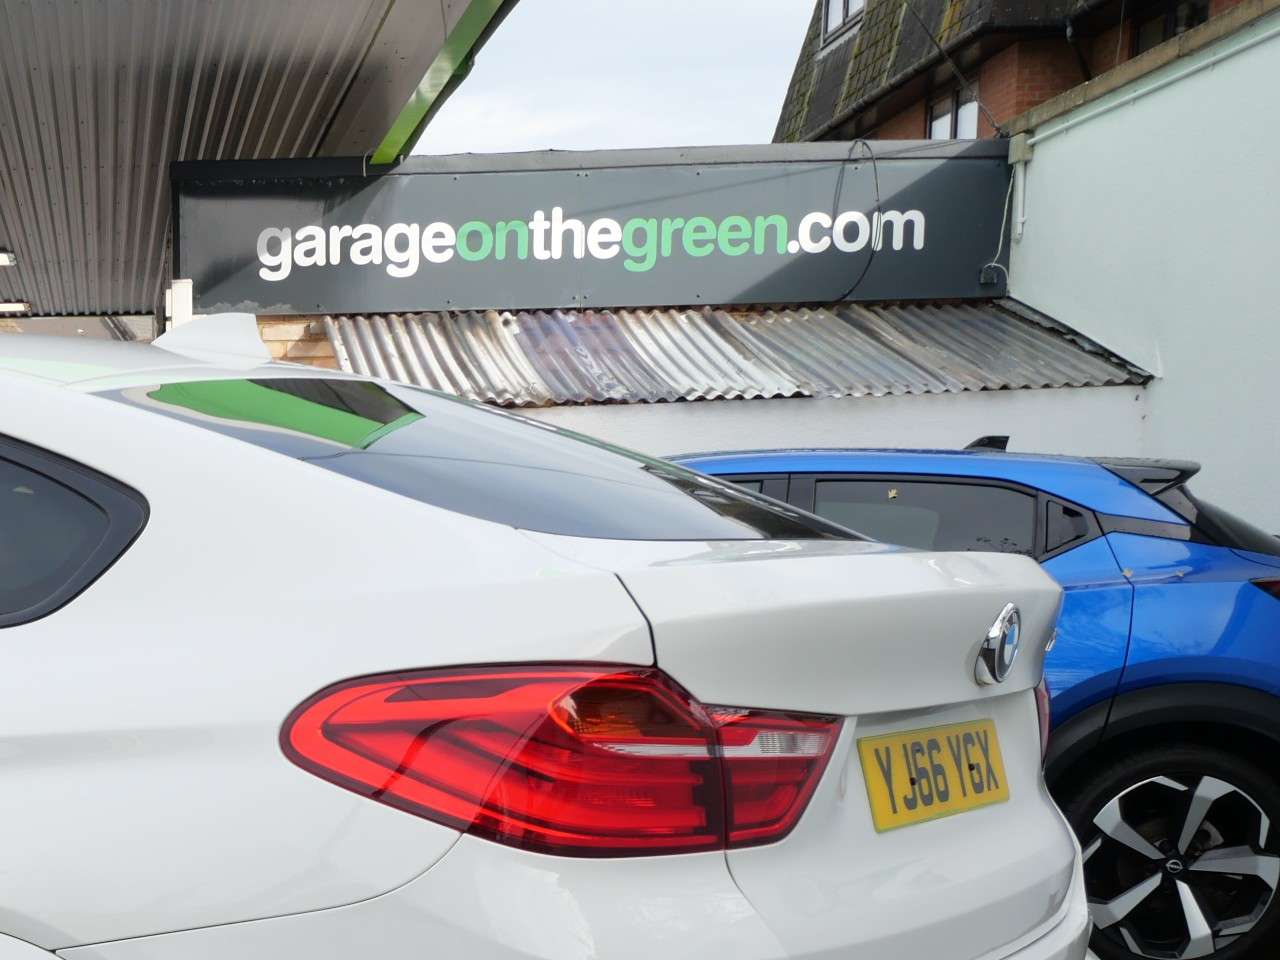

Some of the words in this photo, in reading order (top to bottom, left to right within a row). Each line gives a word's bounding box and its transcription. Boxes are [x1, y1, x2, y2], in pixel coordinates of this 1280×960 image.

[256, 206, 926, 281] garageonthegreen.com
[874, 738, 950, 814] YJ66
[946, 729, 1000, 797] YGX
